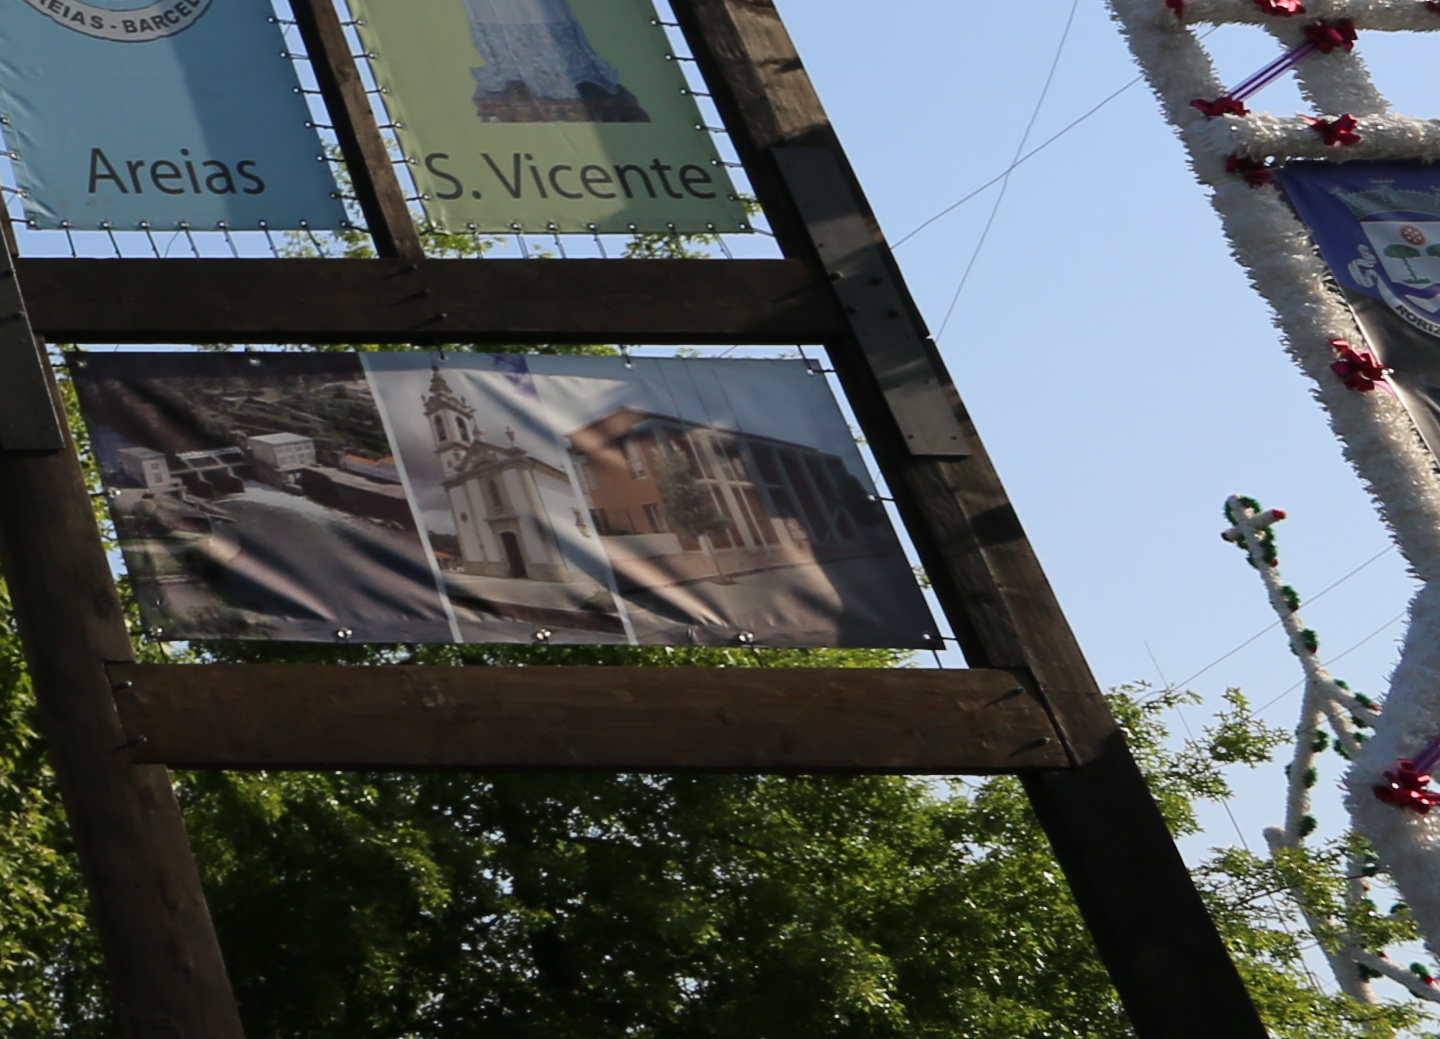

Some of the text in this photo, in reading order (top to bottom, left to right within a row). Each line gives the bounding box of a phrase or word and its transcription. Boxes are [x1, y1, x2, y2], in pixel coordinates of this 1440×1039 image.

[87, 147, 266, 195] Areias
[424, 152, 717, 200] S. Vicente
